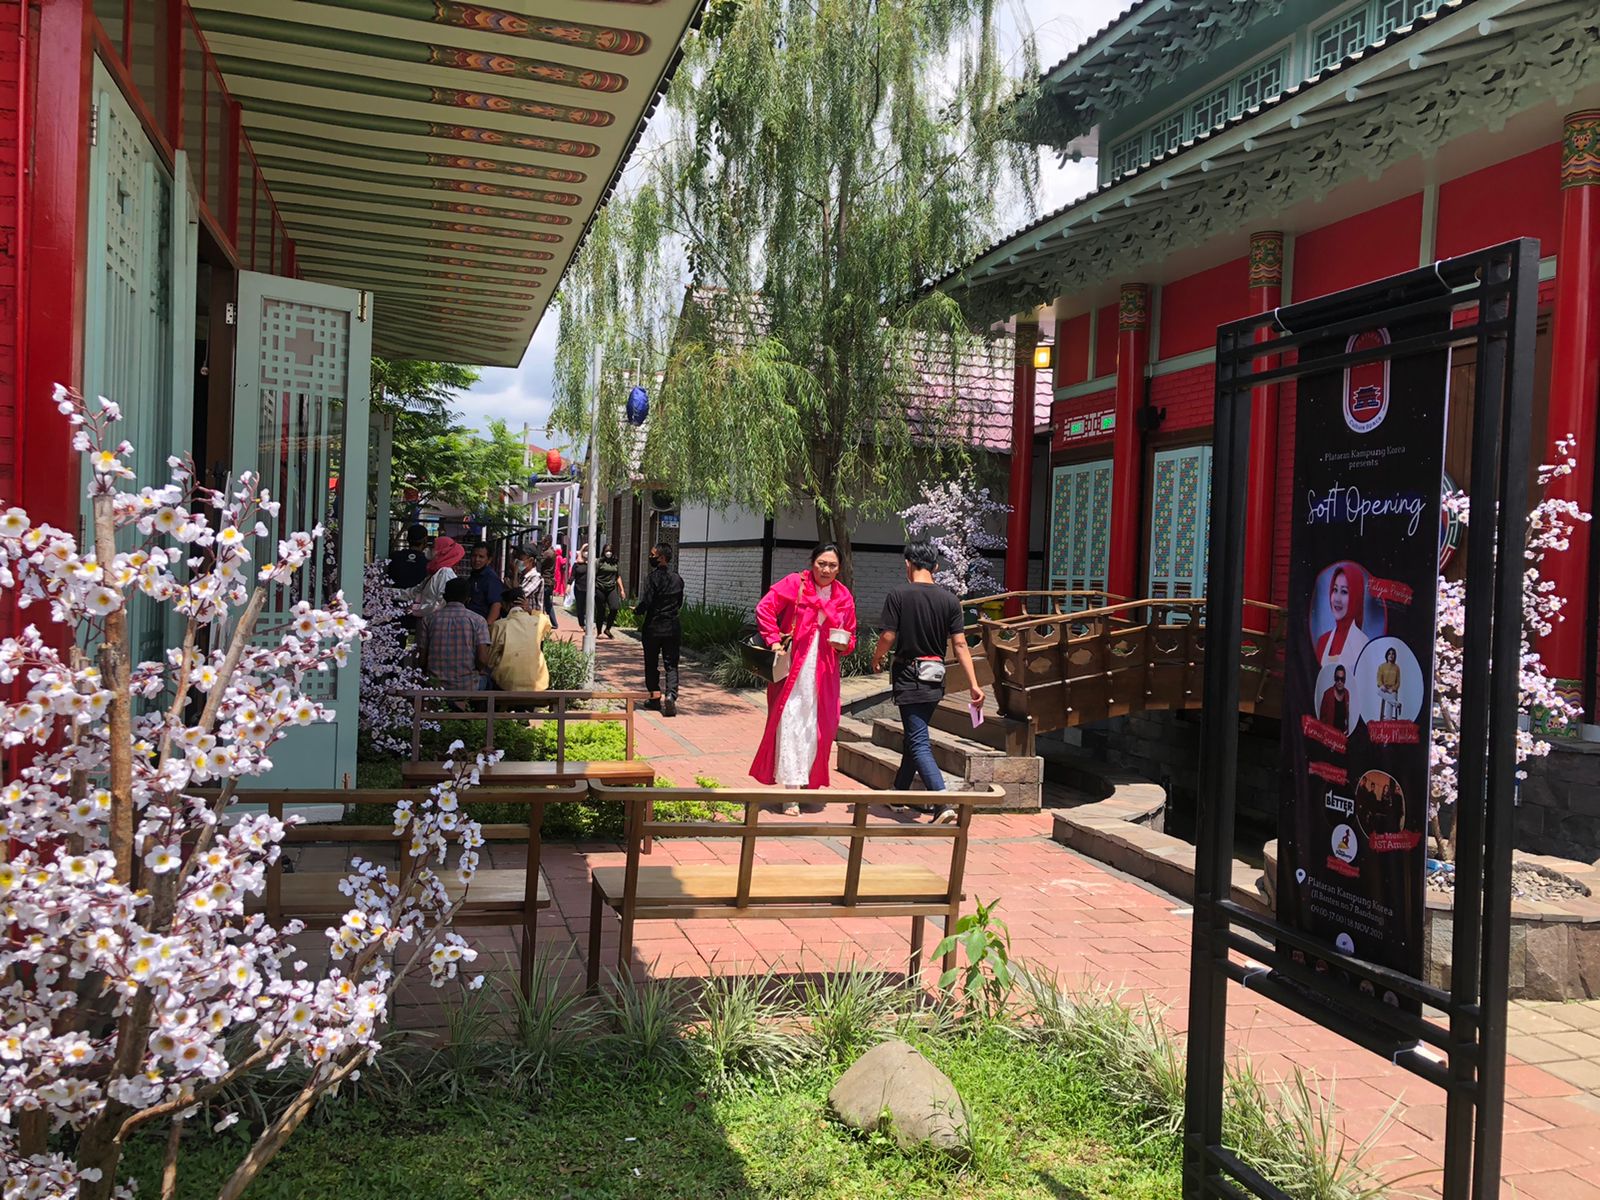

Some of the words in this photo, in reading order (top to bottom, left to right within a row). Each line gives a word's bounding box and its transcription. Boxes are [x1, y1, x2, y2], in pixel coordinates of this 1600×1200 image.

[1351, 448, 1386, 460] Kampung
[1386, 445, 1406, 456] Korea
[1348, 458, 1379, 470] presents
[1307, 481, 1345, 525] Soft
[1345, 485, 1427, 537] Opening
[1327, 795, 1353, 812] BETTER
[1307, 876, 1336, 895] Plataran
[1336, 886, 1372, 909] Kampung
[1372, 899, 1393, 917] Korea
